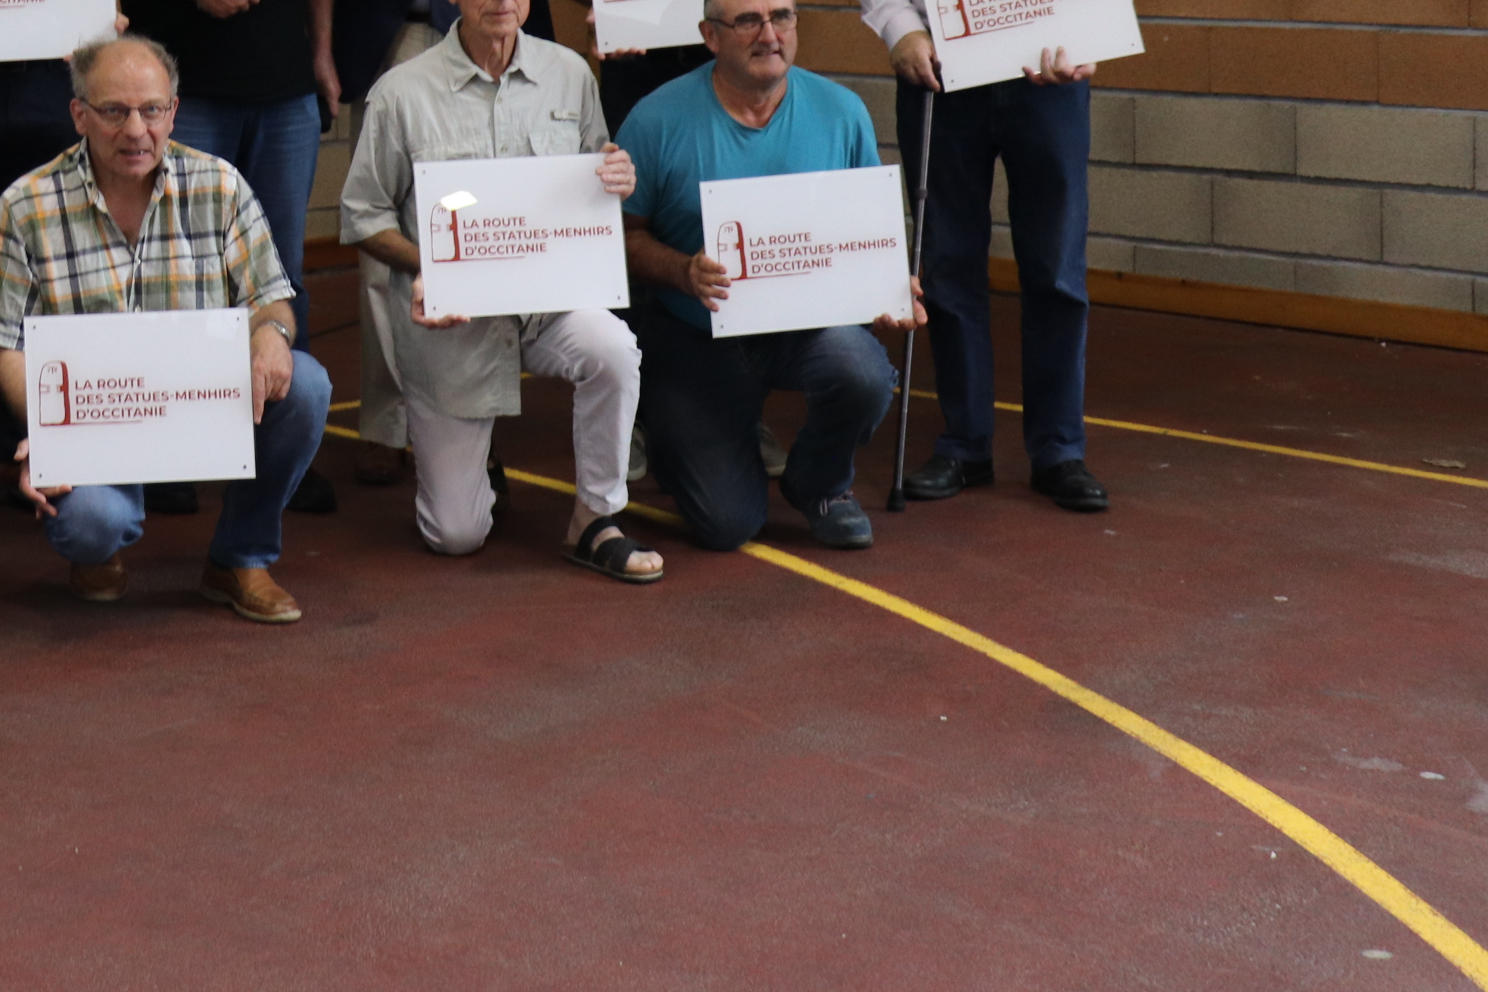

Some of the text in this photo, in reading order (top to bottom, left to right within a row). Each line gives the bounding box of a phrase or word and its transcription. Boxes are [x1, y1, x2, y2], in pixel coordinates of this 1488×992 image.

[971, 5, 996, 18] DES
[974, 7, 1055, 30] D'OCCITANIE
[463, 216, 526, 228] LA ROUTE
[464, 226, 612, 242] DES STATUES-MENHIRS
[749, 231, 811, 247] LA ROUTE
[465, 242, 547, 256] D'OCCITANIE
[750, 238, 897, 260] DES STATUES-MENHIRS
[751, 257, 833, 273] D'OCCITANIE
[75, 377, 145, 390] LA ROUTE
[76, 388, 241, 404] DES STATUES-MENHIRS
[76, 405, 167, 419] D'OCCITANIE
